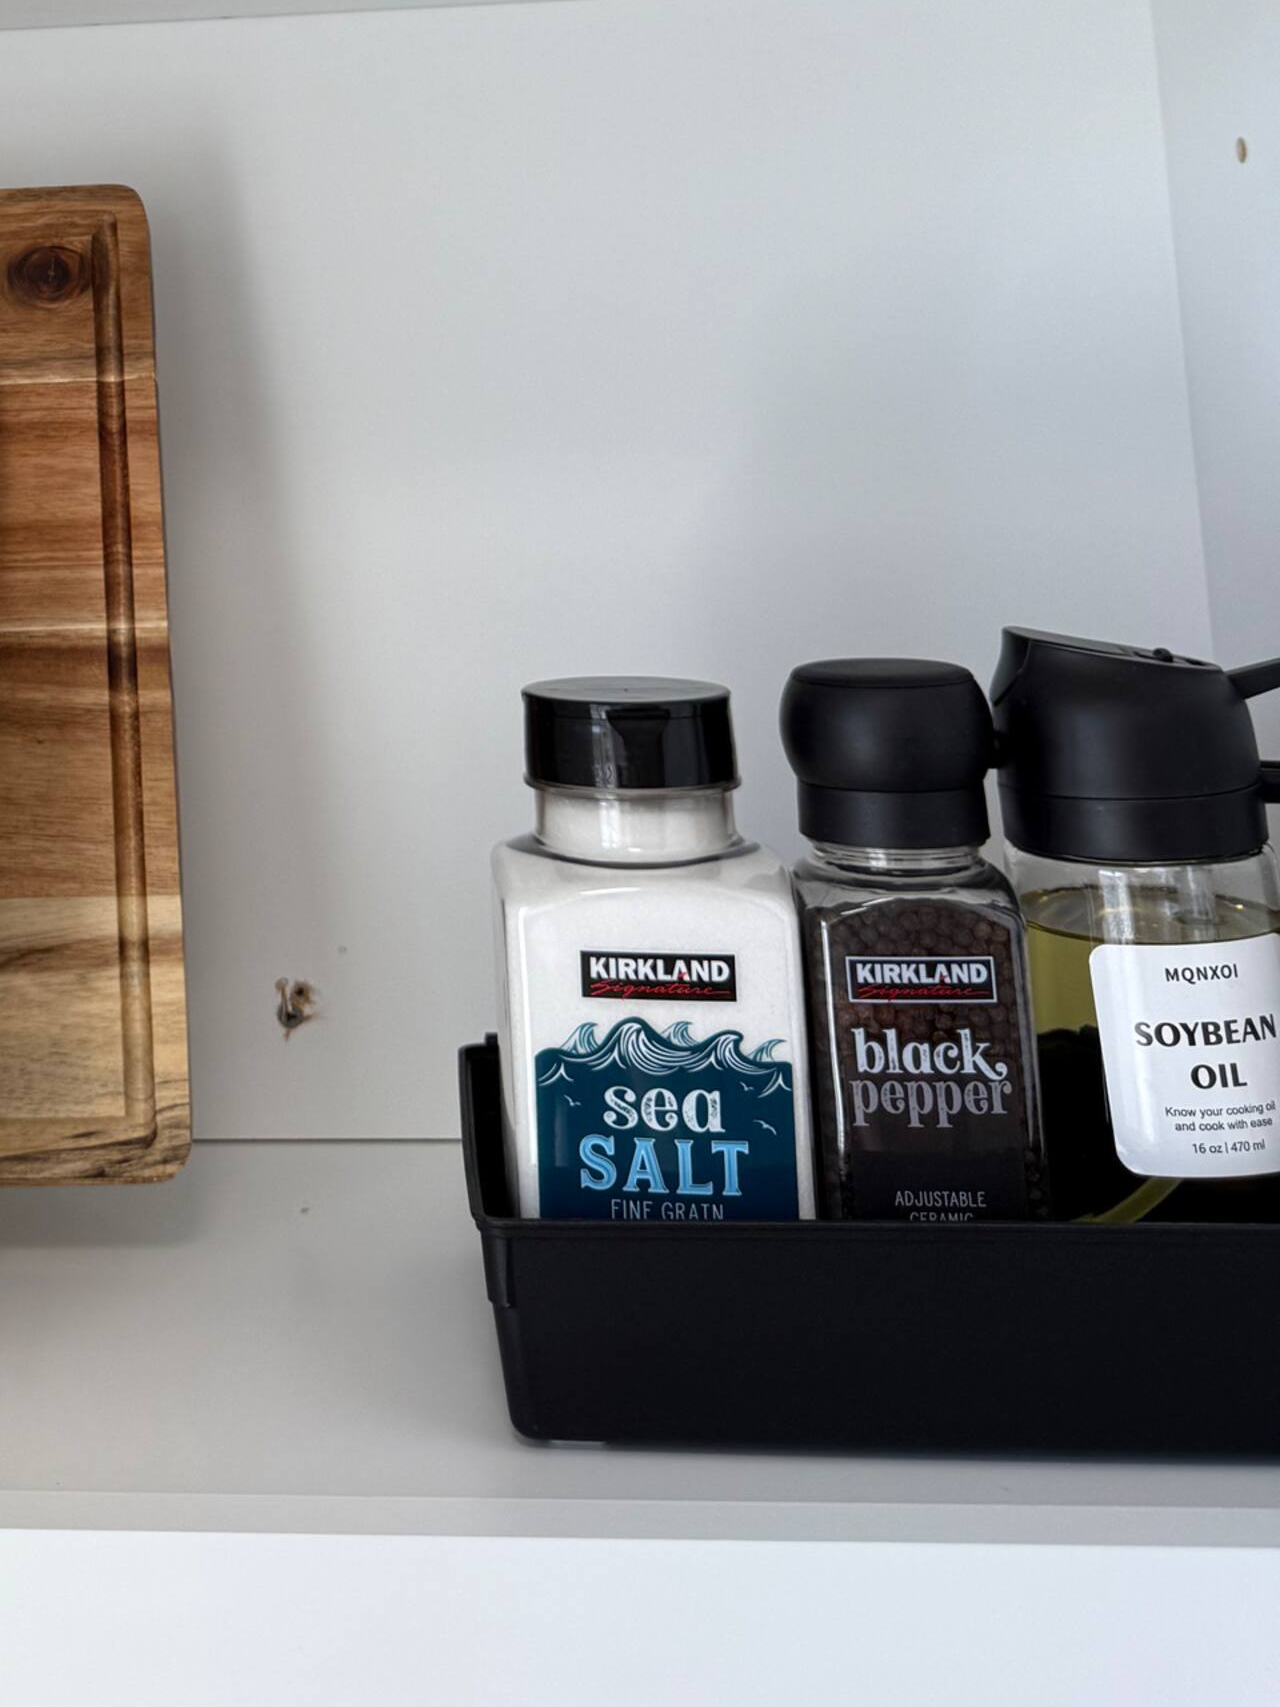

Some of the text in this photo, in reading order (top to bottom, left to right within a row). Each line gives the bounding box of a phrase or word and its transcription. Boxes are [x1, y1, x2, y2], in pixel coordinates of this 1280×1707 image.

[589, 956, 730, 982] KIRKLAND
[856, 963, 988, 984] KIRKLAND
[1165, 963, 1238, 985] MQNXOI
[590, 979, 730, 999] Signature
[857, 985, 991, 1001] Signature
[1134, 1013, 1278, 1047] SOYBEAN
[851, 1027, 1008, 1081] black
[1190, 1062, 1248, 1090] OIL
[602, 1085, 726, 1133] sea
[849, 1079, 1013, 1128] pepper
[1165, 1100, 1276, 1119] Know your cooking oil
[1175, 1117, 1273, 1132] and cook with ease
[1192, 1143, 1207, 1154] 16
[1209, 1144, 1223, 1154] oz
[1230, 1140, 1251, 1152] 470
[1252, 1139, 1266, 1151] ml
[579, 1133, 750, 1196] SALT
[895, 1190, 987, 1207] ADJUSTABLE
